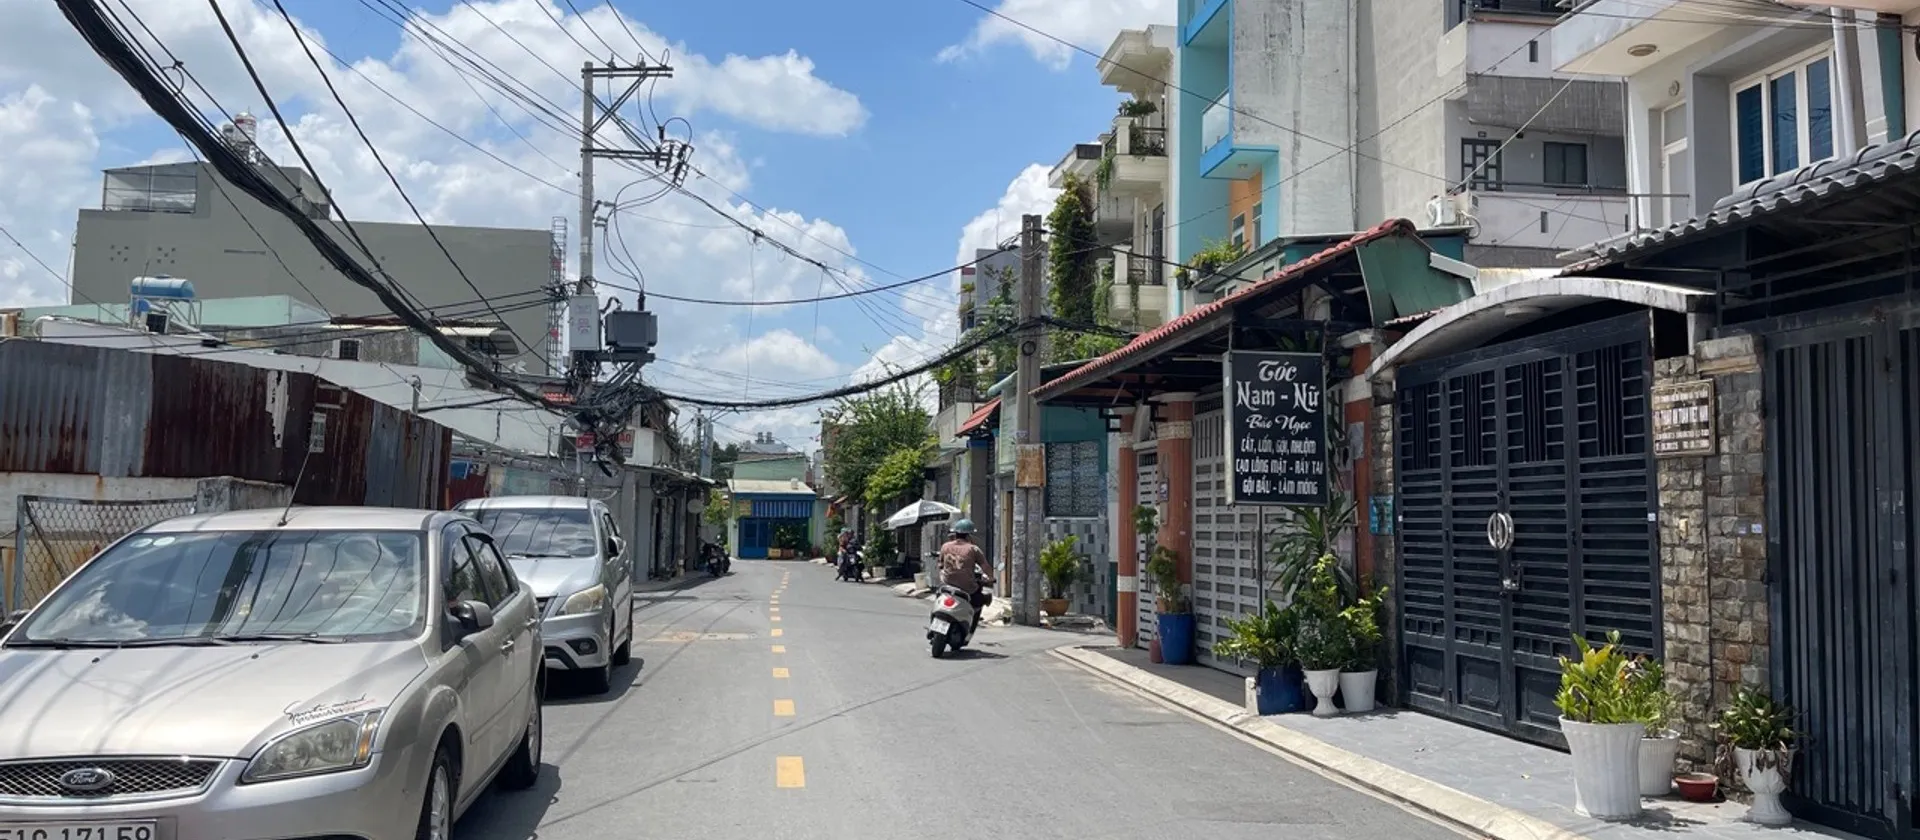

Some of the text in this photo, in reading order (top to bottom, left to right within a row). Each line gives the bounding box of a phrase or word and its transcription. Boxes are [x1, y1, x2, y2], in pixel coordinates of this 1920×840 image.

[1257, 360, 1297, 382] Tóc
[1236, 380, 1276, 411] Nam
[1293, 382, 1320, 413] Nữ
[70, 772, 98, 784] Ford
